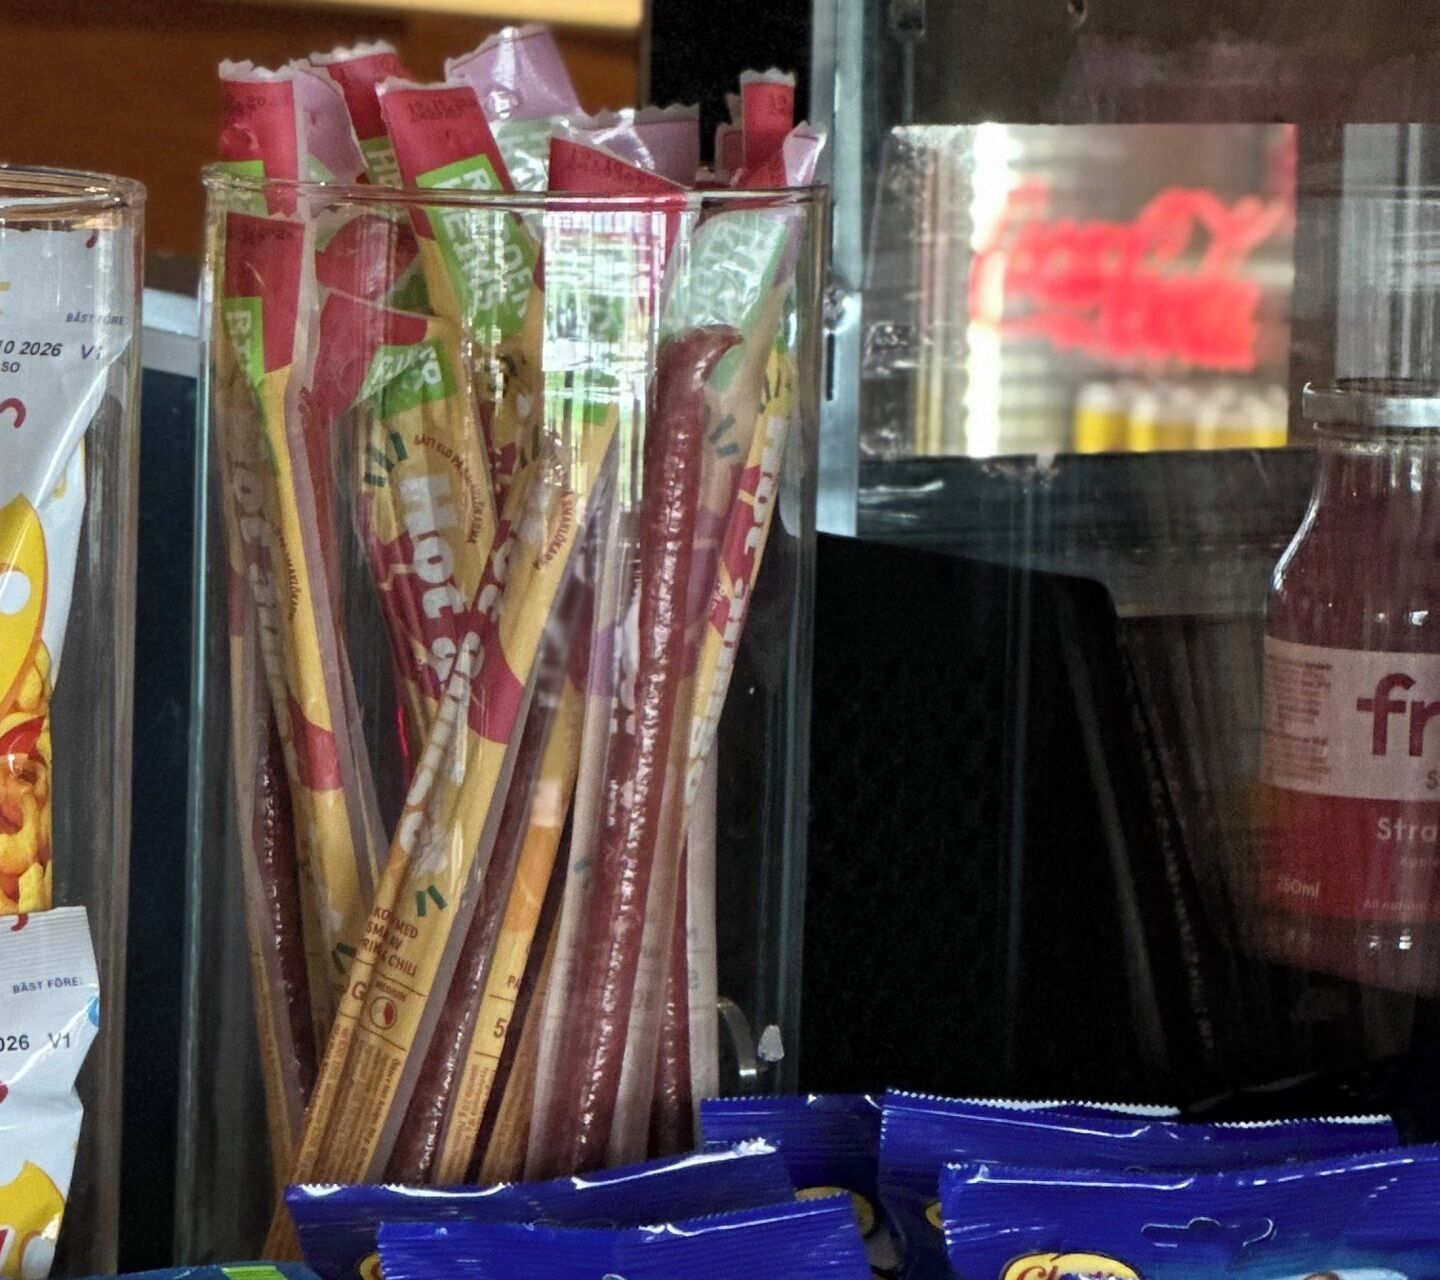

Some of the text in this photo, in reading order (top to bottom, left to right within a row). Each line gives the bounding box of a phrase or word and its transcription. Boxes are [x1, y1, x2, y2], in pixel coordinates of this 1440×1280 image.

[18, 341, 64, 358] 2026
[1356, 672, 1440, 757] fr
[1376, 816, 1439, 843] Stra
[11, 980, 44, 995] BÄST
[493, 1018, 508, 1039] 5
[47, 1029, 73, 1050] V1
